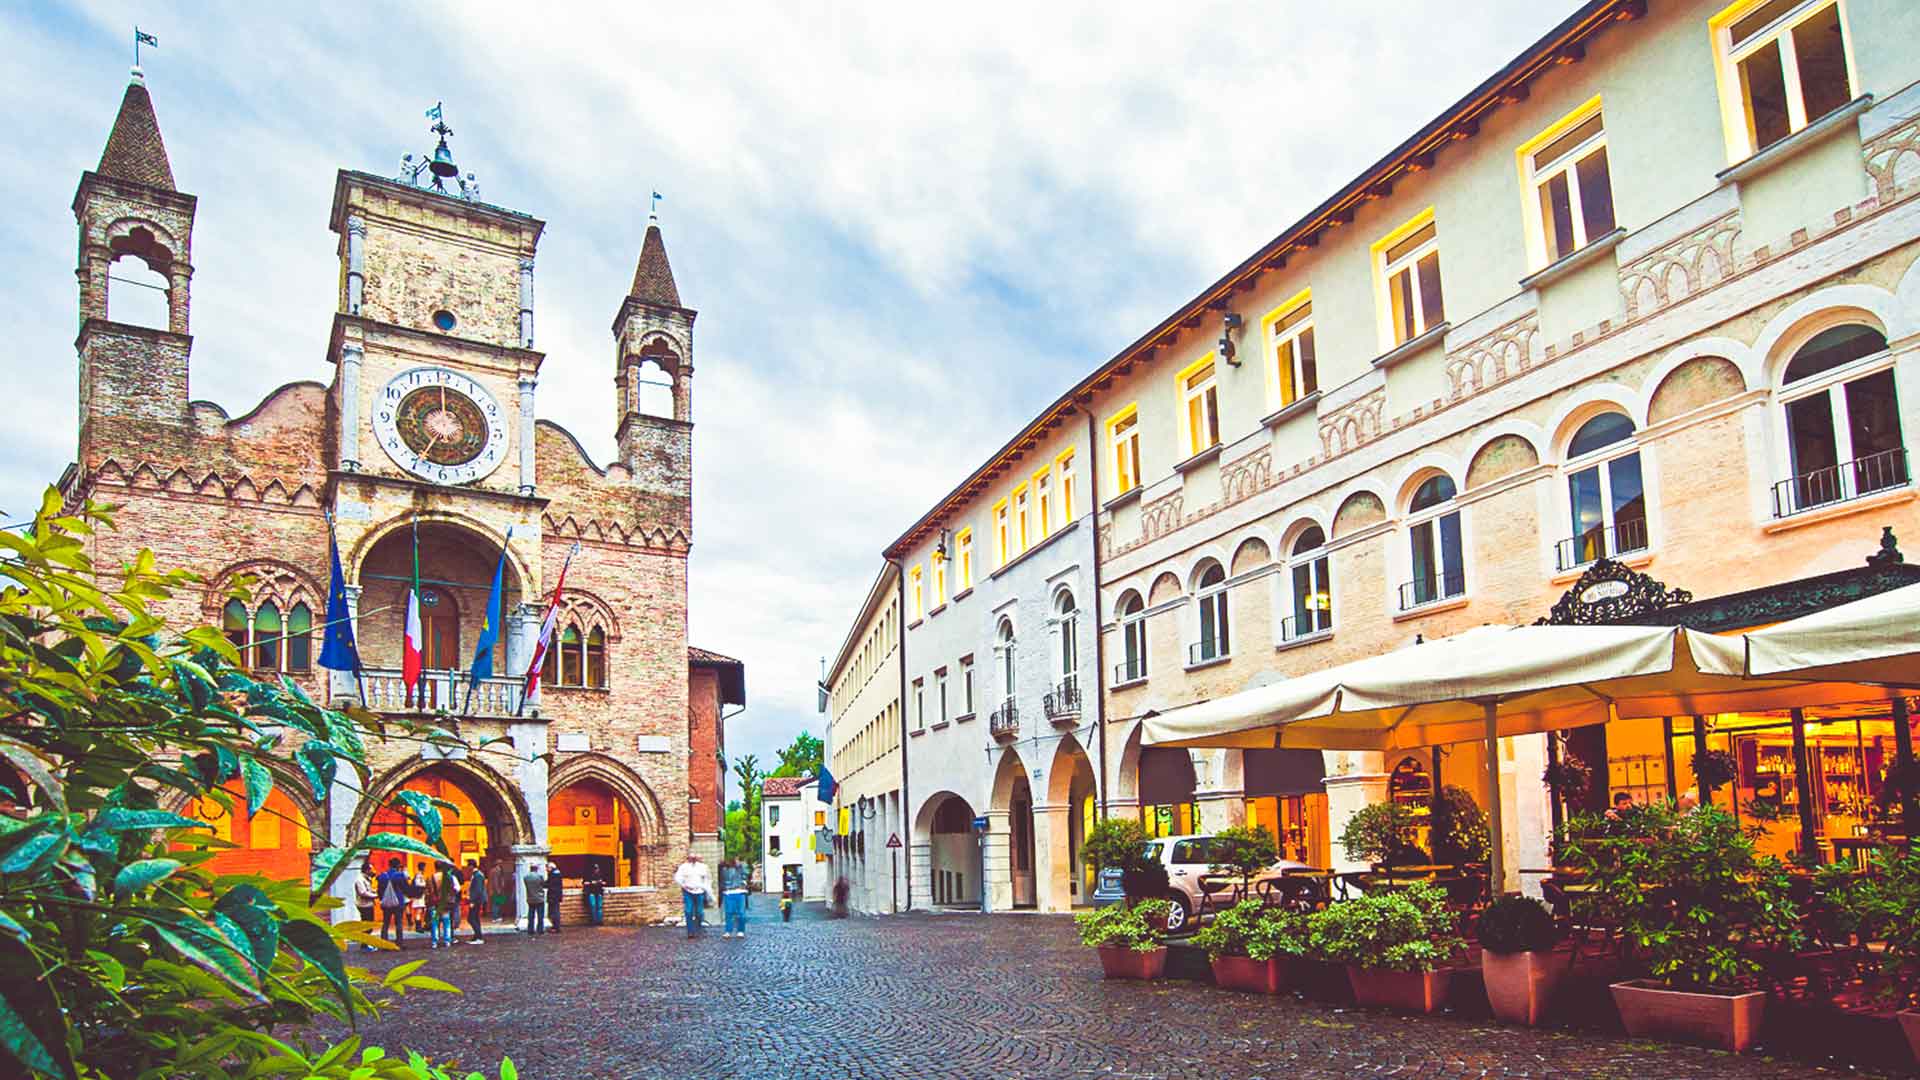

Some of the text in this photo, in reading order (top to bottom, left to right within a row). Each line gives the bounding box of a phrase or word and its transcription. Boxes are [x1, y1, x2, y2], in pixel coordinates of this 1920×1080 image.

[408, 372, 420, 385] 11
[386, 387, 401, 400] 10
[487, 403, 497, 417] 2
[380, 411, 390, 423] 9
[387, 437, 398, 449] 8
[485, 449, 494, 461] 4
[411, 457, 420, 470] 7
[438, 469, 448, 480] 6
